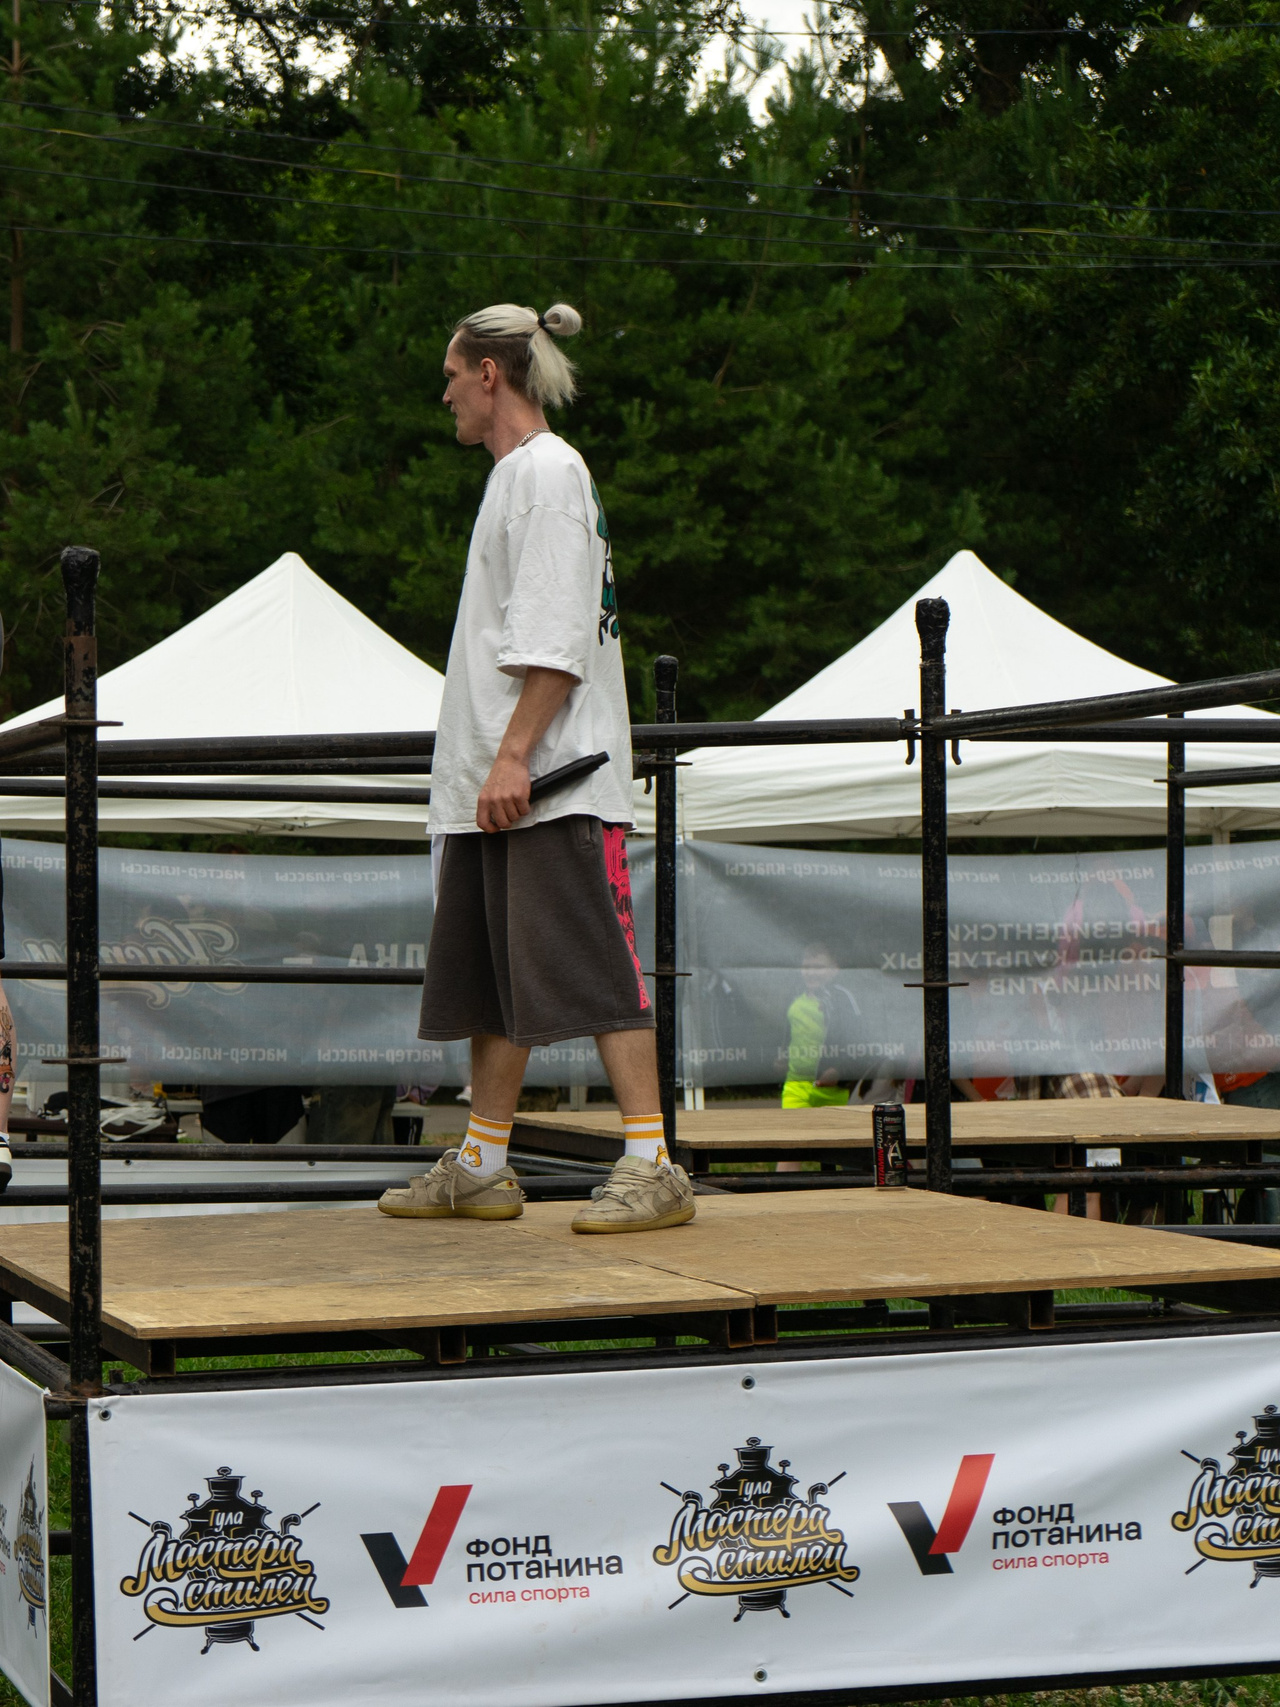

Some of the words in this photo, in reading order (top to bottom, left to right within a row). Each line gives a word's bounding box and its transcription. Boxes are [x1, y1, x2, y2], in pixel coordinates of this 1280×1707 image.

[1254, 1445, 1280, 1469] Тул
[737, 1478, 773, 1502] Тула
[207, 1508, 245, 1533] Тула
[652, 1499, 844, 1566] Мастера
[120, 1530, 314, 1597] Мастера
[992, 1556, 1038, 1571] сила
[1042, 1551, 1110, 1569] спорта
[469, 1589, 517, 1605] сила
[520, 1585, 590, 1603] спорта
